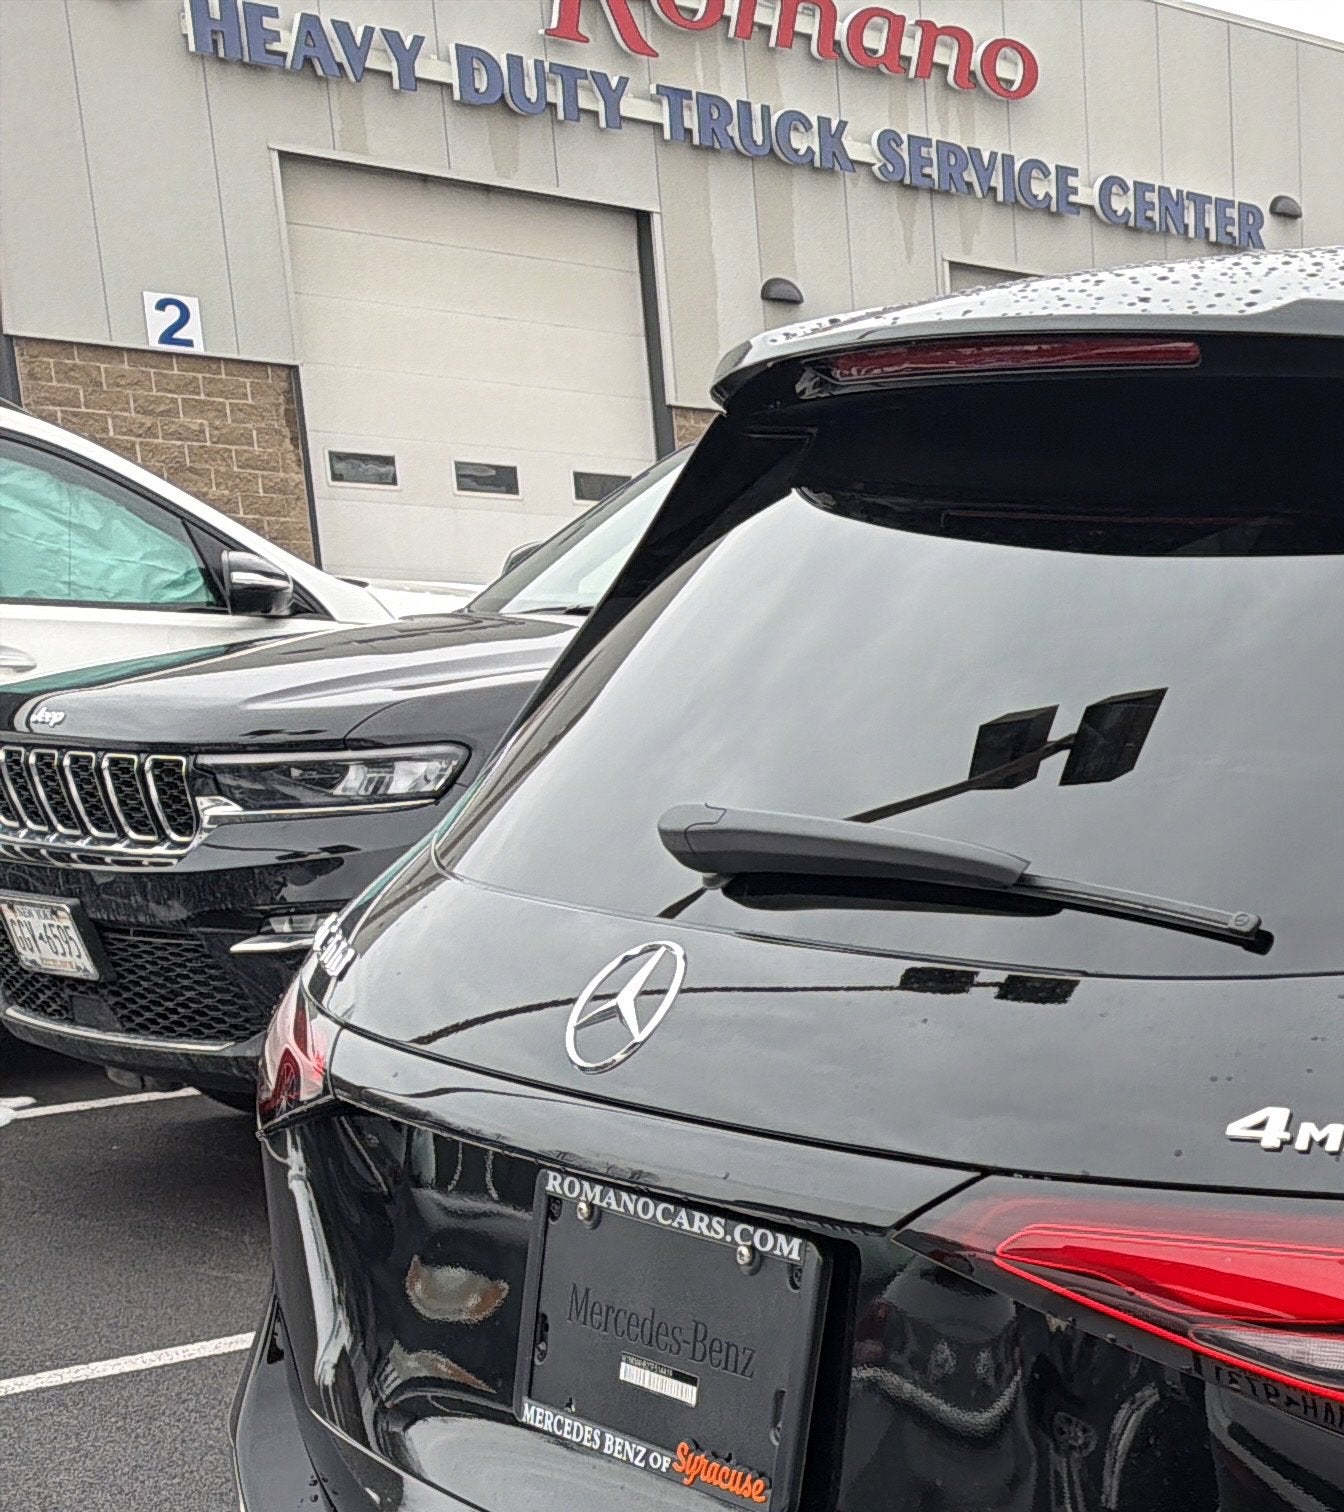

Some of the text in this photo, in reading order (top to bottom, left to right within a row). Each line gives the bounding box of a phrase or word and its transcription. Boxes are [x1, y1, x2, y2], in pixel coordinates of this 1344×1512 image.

[189, 0, 1265, 250] HEAVY DUTY TRUCK SERVICE CENTER
[154, 297, 195, 349] 2
[30, 706, 66, 728] Jeep
[545, 1171, 802, 1261] ROMANOCARS.COM
[567, 1283, 757, 1380] Mercedes-Benz
[521, 1402, 768, 1504] MERCEDES BENZ OF Syracuse
